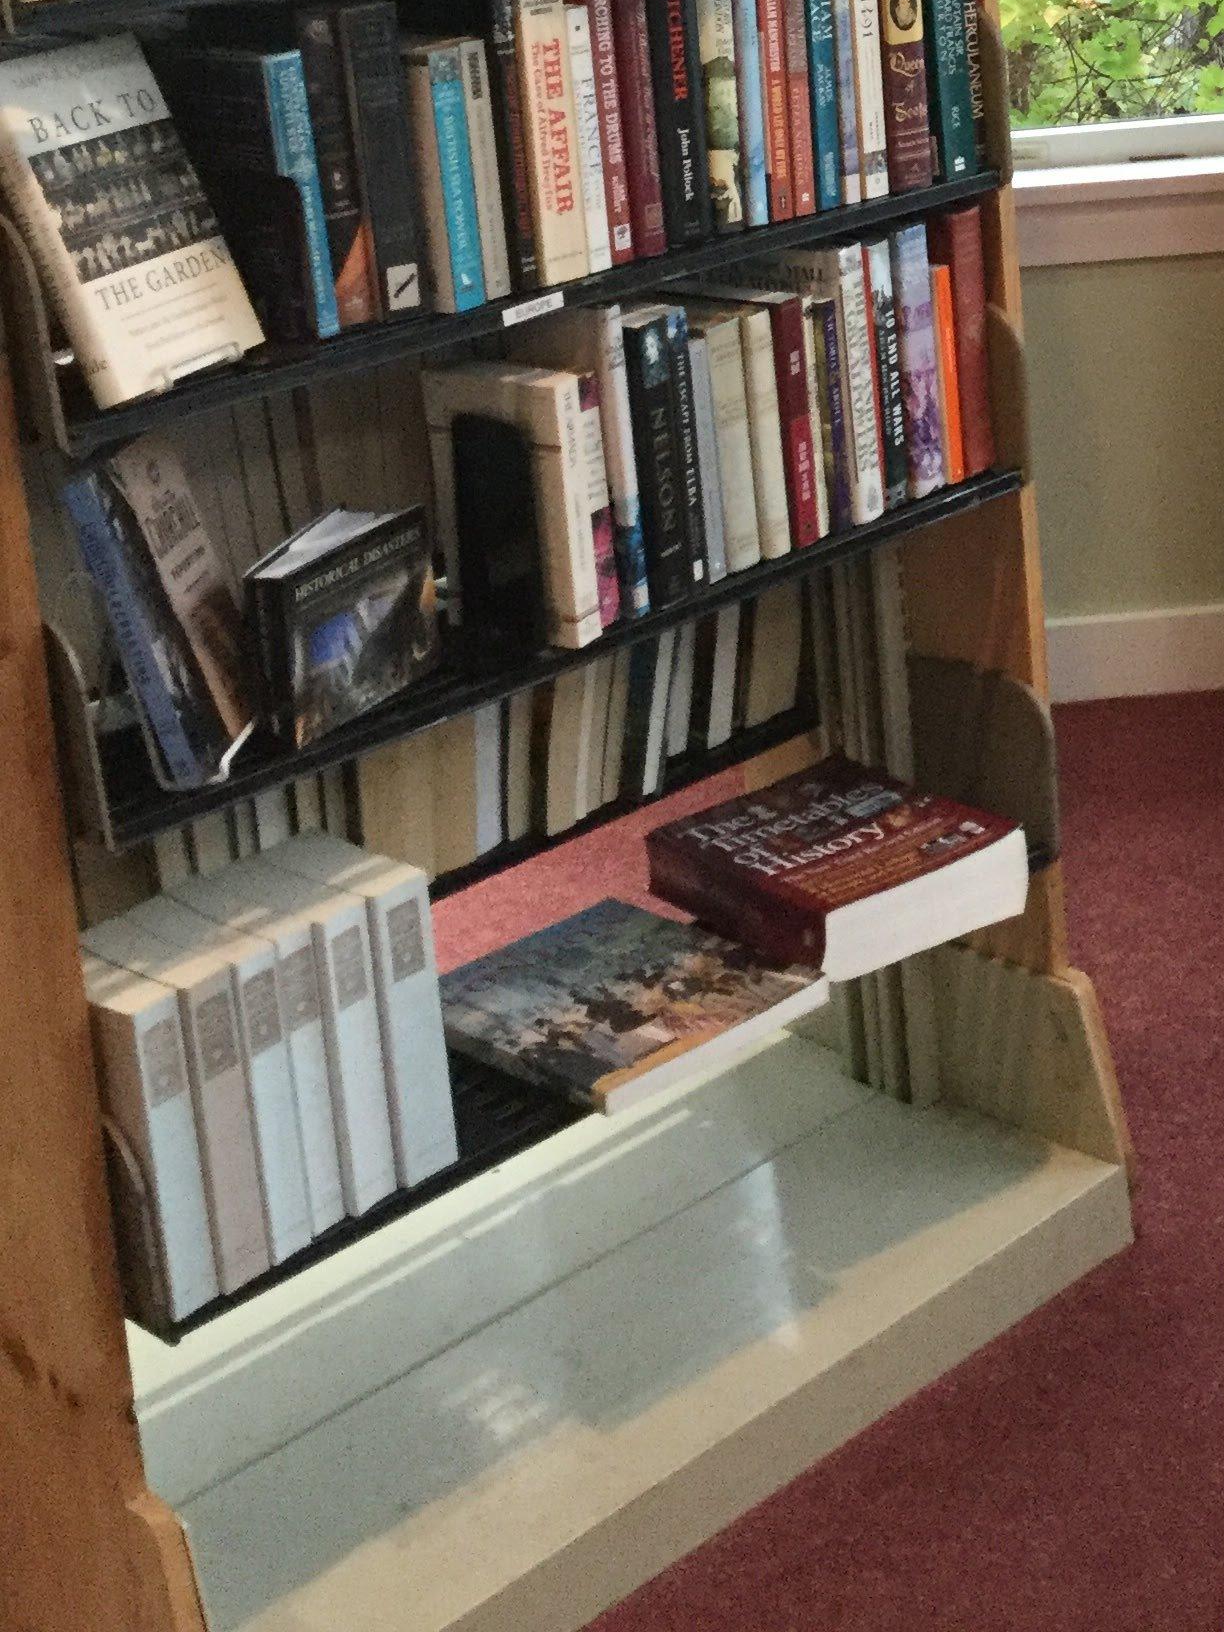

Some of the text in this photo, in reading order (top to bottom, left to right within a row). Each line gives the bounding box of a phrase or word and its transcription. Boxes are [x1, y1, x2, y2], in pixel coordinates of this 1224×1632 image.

[530, 44, 540, 66] The
[599, 55, 613, 76] TO
[944, 31, 956, 75] FRANCIS
[955, 39, 964, 55] SIR
[962, 1, 984, 119] HERCULANEUM
[29, 89, 155, 144] BACK TO
[601, 79, 617, 110] THE
[539, 38, 574, 214] THE AFFAIR
[604, 113, 622, 163] DRUMS
[677, 127, 695, 200] John Pollock
[95, 249, 228, 311] THE GARDEN
[884, 309, 895, 329] TO
[885, 335, 898, 365] END
[888, 371, 901, 398] ALL
[676, 353, 697, 506] THE ESCAPE FROM ELBA
[889, 403, 905, 446] WARS
[652, 406, 679, 532] NELSON
[682, 814, 754, 849] The
[749, 822, 886, 877] History
